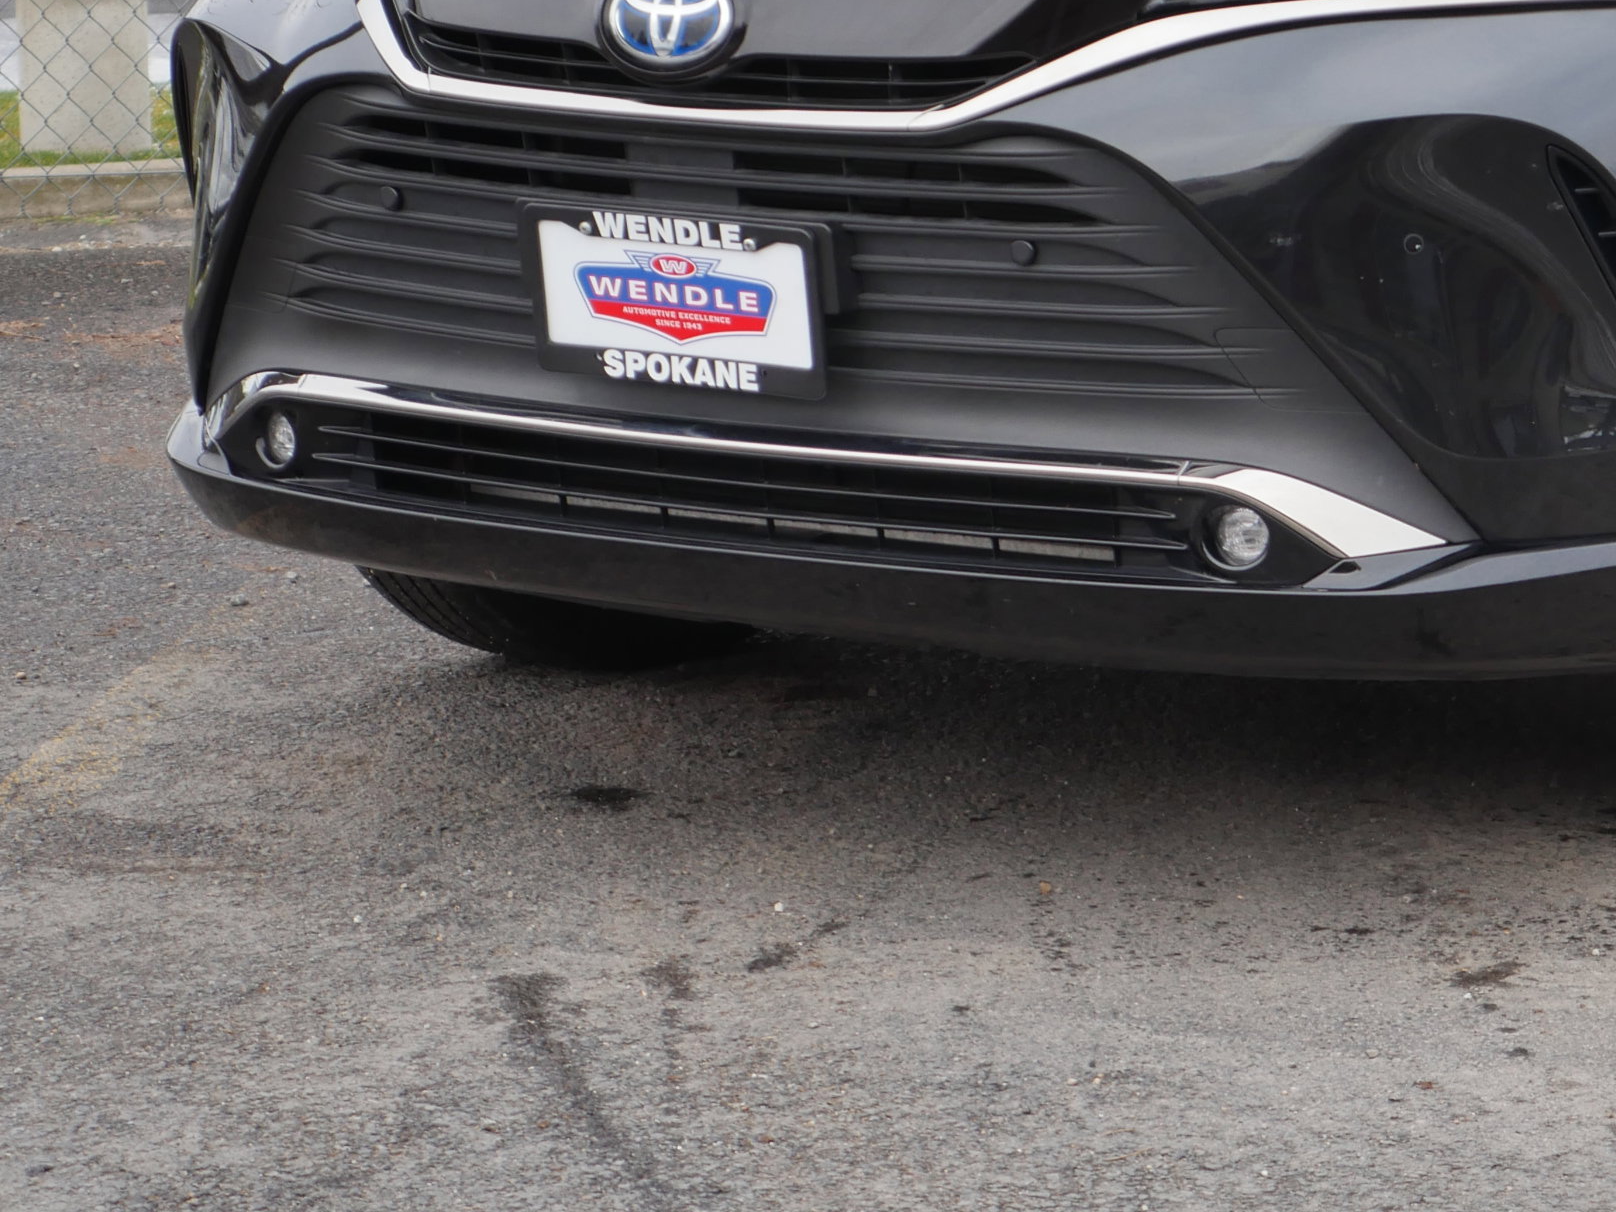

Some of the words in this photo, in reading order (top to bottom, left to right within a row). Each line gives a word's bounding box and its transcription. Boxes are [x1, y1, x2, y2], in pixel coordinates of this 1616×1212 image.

[592, 211, 743, 250] WENDLE
[588, 275, 759, 313] WENDLE
[622, 305, 676, 319] AUTOMOTIVE
[678, 311, 731, 325] EXCELLENCE
[655, 318, 681, 329] SINCE
[683, 321, 703, 331] 1943
[603, 348, 760, 392] SPOKANE
